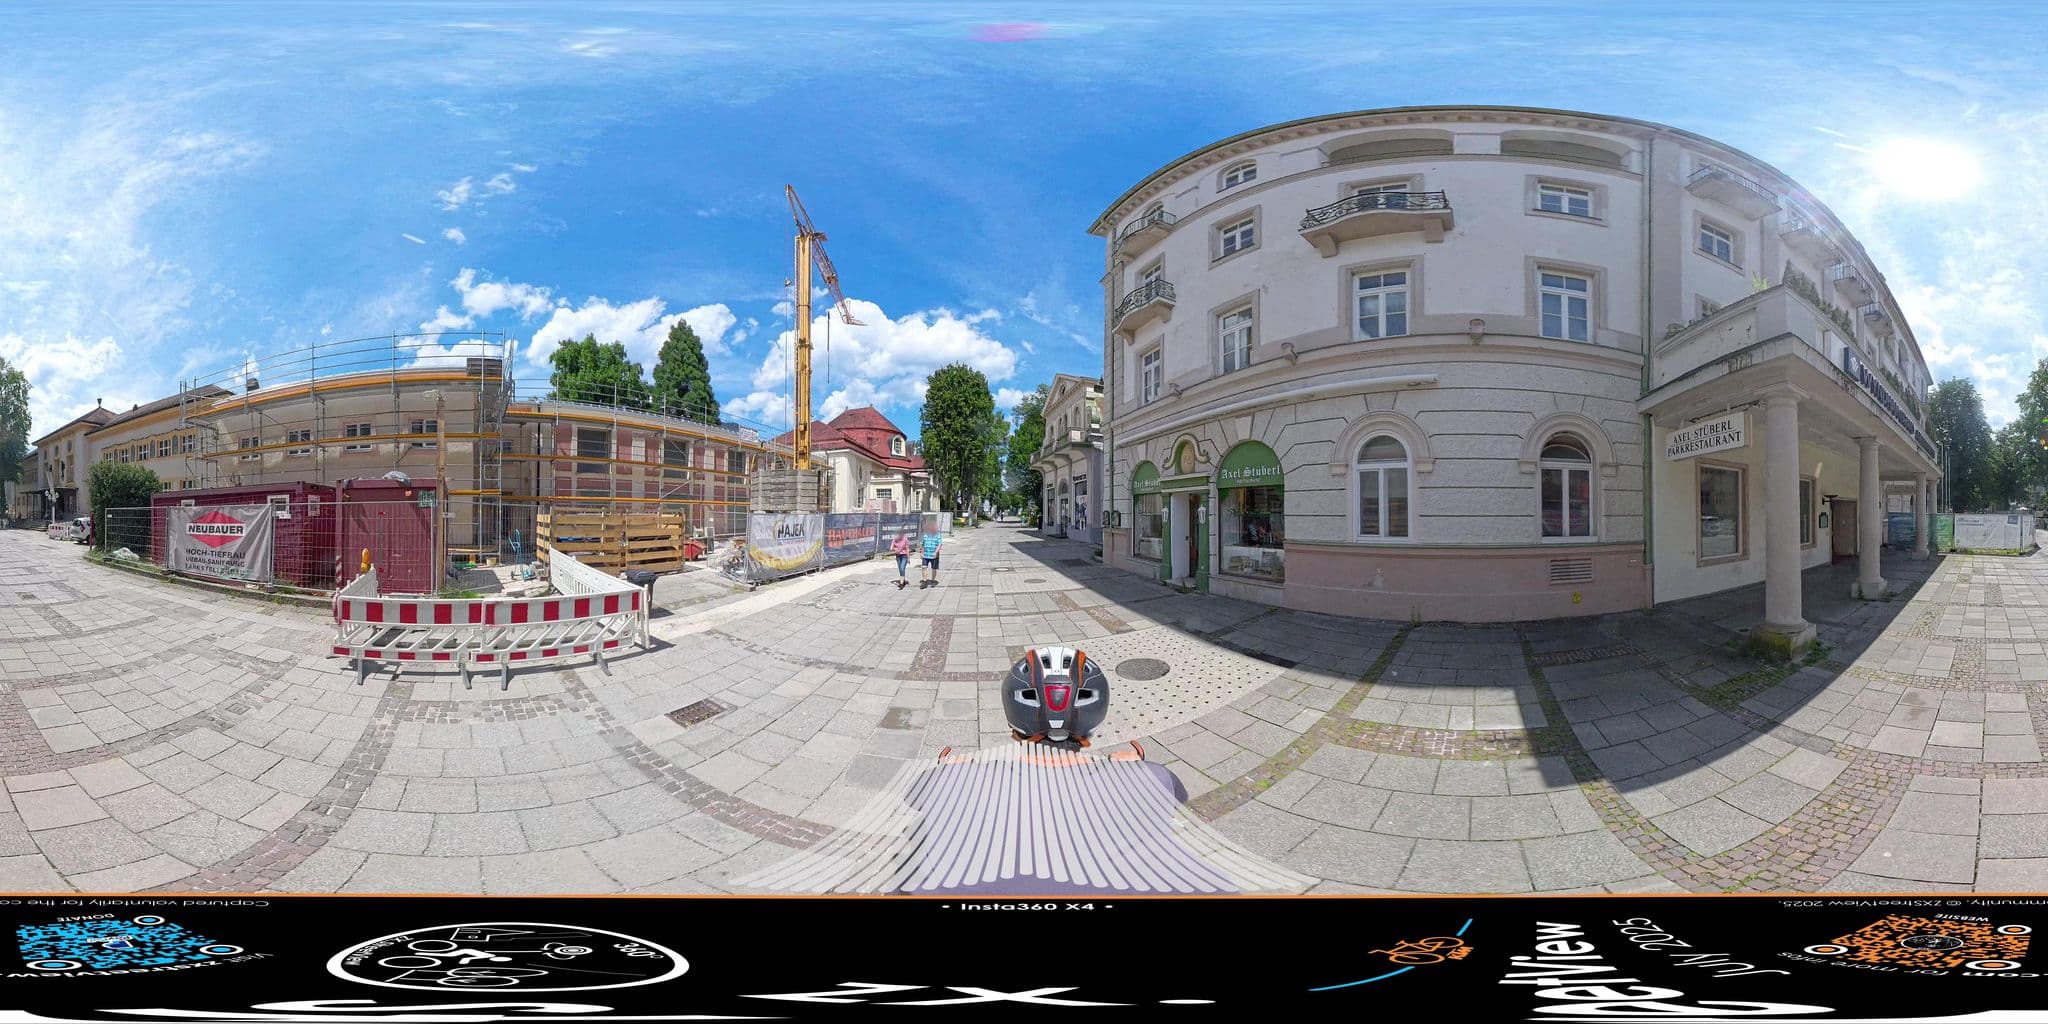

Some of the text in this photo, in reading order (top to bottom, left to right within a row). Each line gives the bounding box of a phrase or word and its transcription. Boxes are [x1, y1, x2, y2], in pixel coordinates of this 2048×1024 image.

[1667, 431, 1741, 457] PARKRESTAURANT
[1221, 468, 1241, 479] Axel
[188, 525, 244, 534] NEUBAUER
[185, 549, 246, 559] HOCH-TIEFBAU
[185, 556, 245, 568] UMBAU-SANIERUNG
